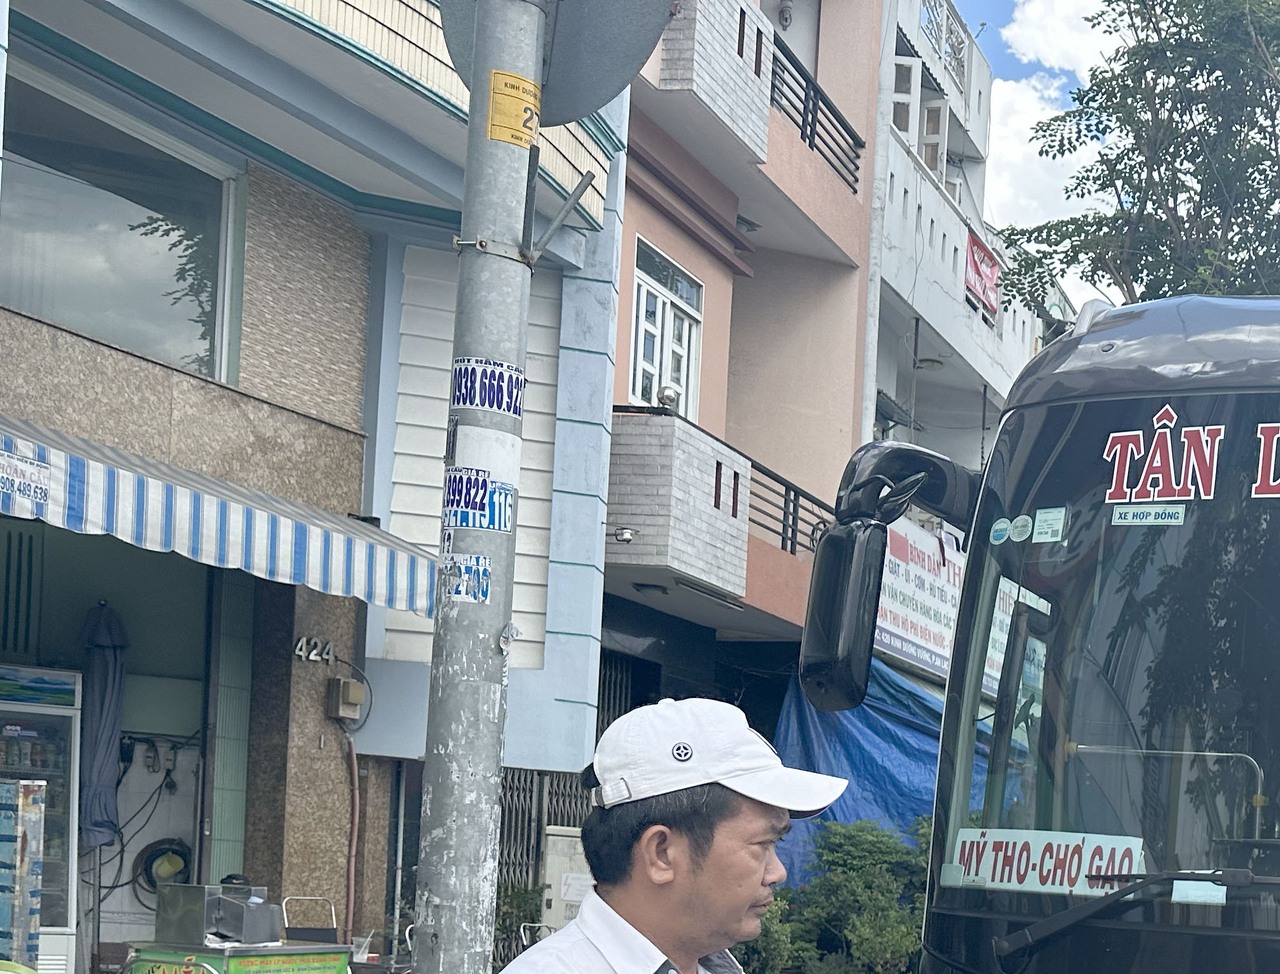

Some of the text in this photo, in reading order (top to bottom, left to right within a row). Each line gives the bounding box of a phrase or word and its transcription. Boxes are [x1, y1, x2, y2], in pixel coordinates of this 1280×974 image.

[504, 81, 520, 92] KINH
[1103, 404, 1226, 504] TÂN
[1118, 511, 1129, 521] XE
[1132, 510, 1152, 522] HỢP
[295, 636, 334, 664] 424
[959, 830, 988, 877] MỸ
